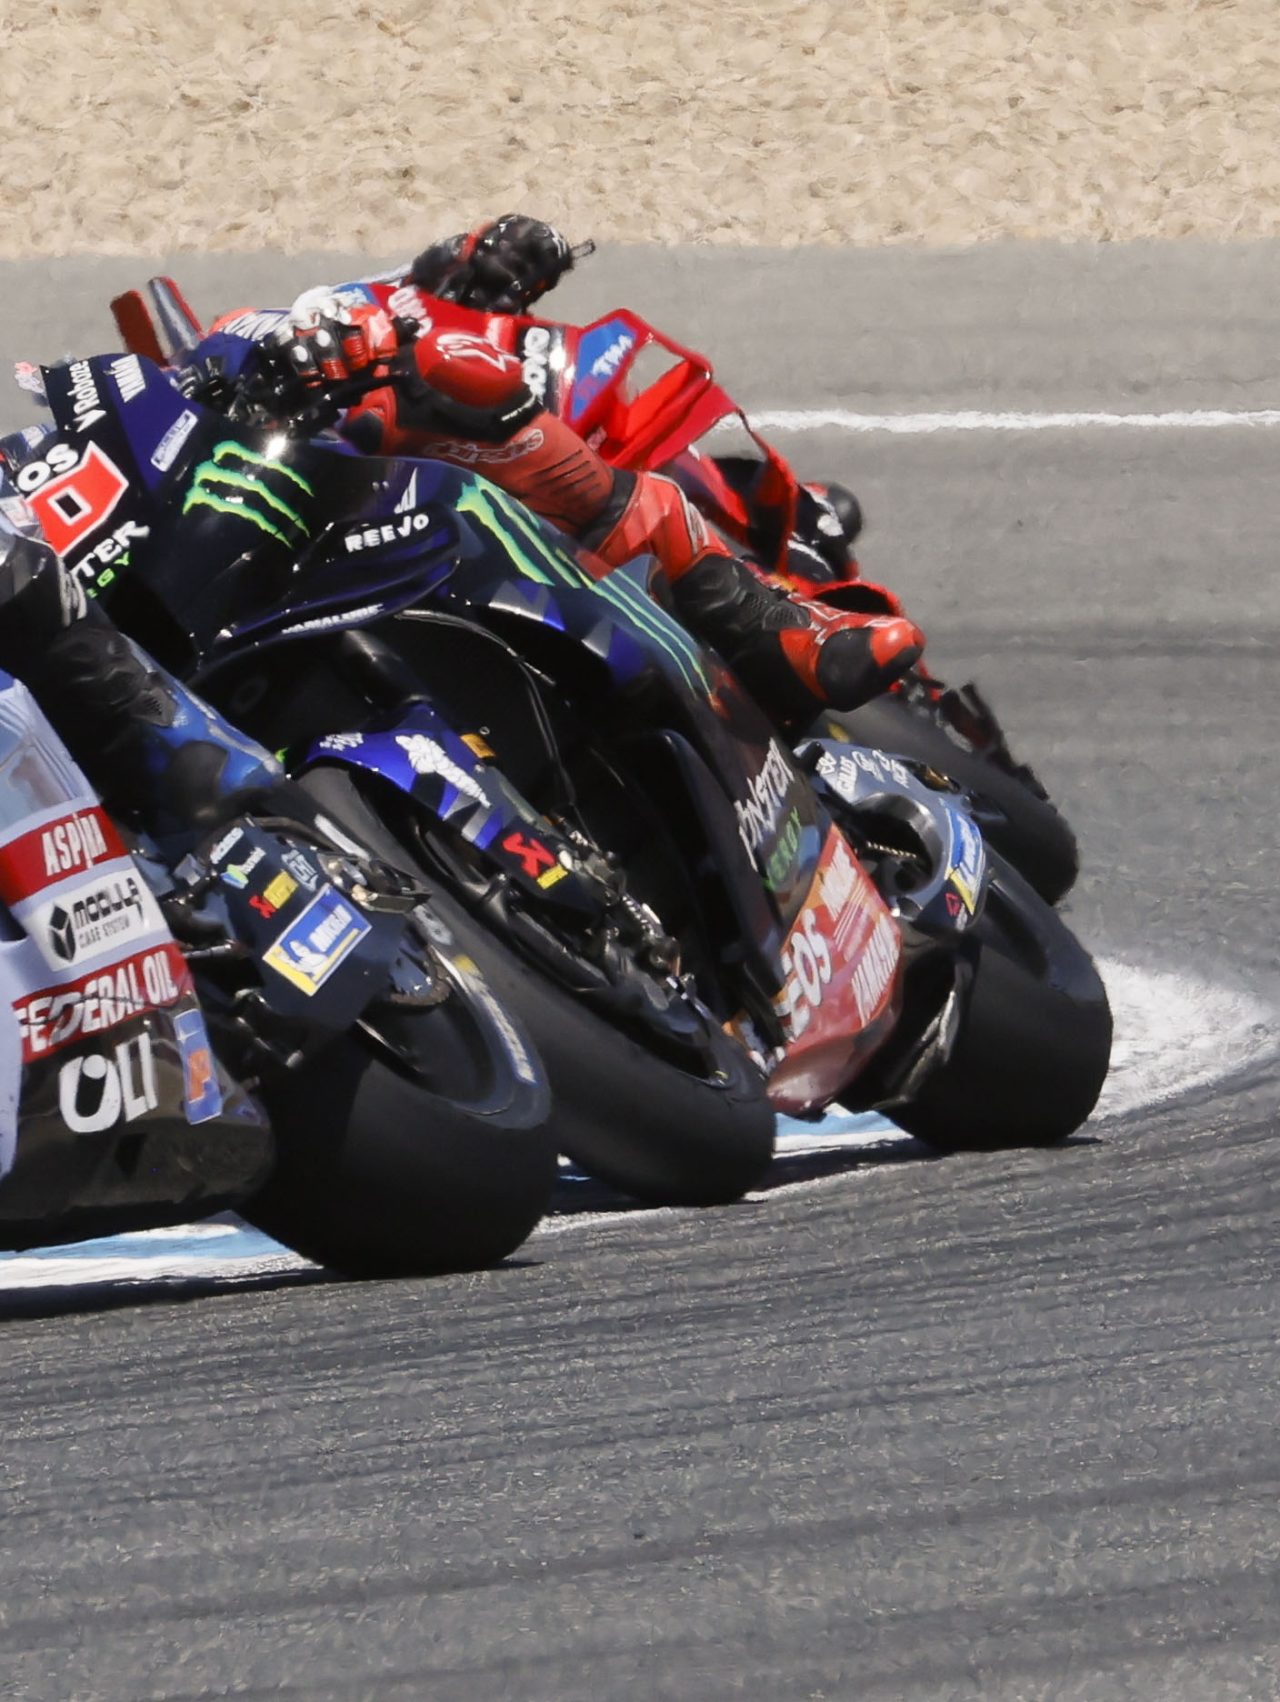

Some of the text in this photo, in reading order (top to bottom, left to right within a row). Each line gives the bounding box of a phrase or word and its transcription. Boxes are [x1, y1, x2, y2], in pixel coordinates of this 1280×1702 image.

[344, 514, 430, 553] REEVO
[13, 950, 179, 1054] FEDERAL OIL
